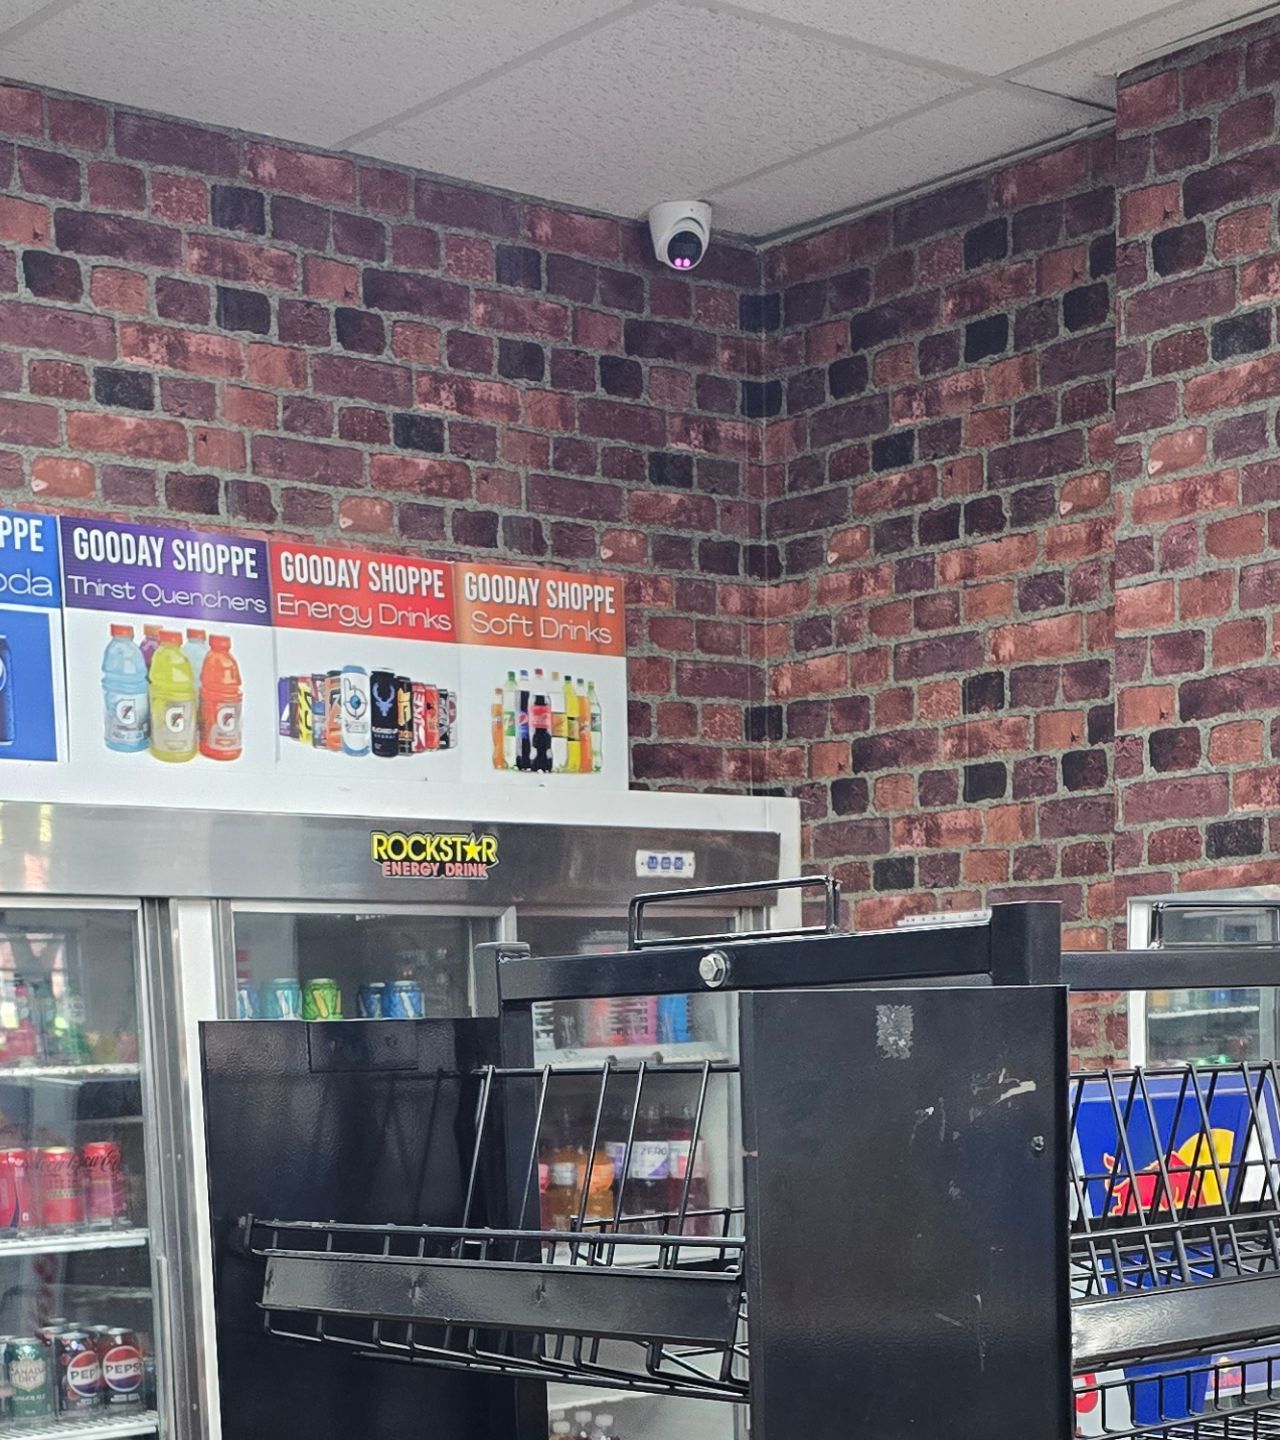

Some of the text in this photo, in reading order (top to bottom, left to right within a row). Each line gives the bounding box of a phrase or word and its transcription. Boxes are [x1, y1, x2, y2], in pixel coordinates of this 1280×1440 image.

[73, 527, 258, 579] GOODAY SHOPPE
[67, 574, 267, 614] Thirst Quenchers
[280, 551, 445, 598] GOODAY SHOPPE
[464, 572, 616, 614] GOODAY SHOPPE
[277, 592, 452, 631] Energy Drinks
[471, 610, 613, 644] Soft Drinks
[382, 861, 489, 878] ENERGY DRINK
